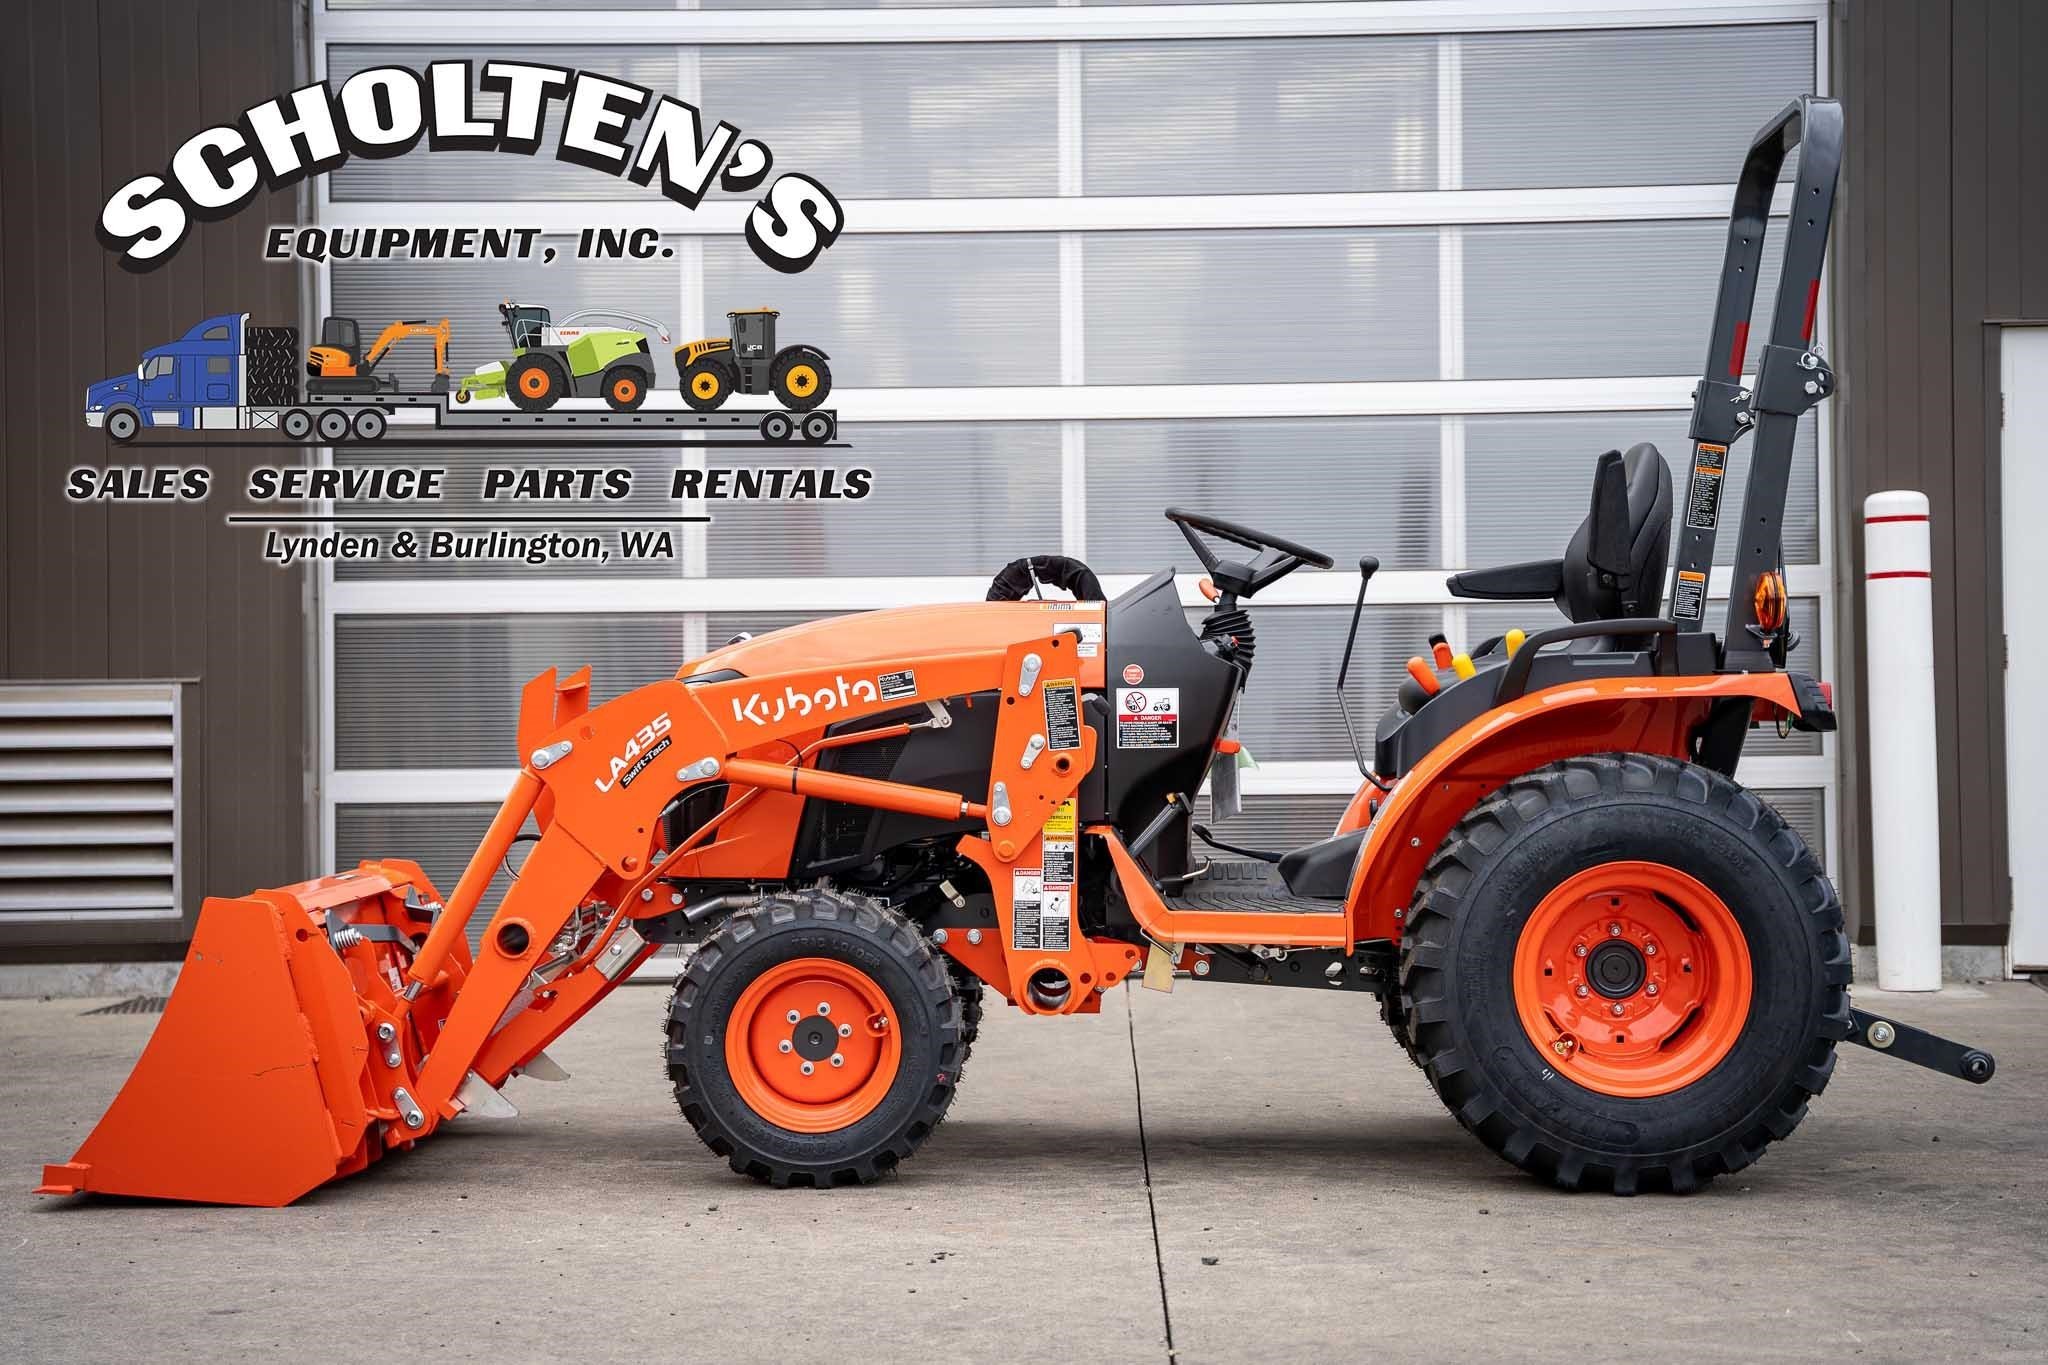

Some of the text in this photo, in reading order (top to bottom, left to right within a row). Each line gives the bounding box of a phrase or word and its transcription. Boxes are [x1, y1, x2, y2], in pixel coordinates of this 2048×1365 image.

[732, 674, 878, 727] Kubota
[594, 711, 673, 794] LA435
[621, 738, 671, 788] Swift-Tach
